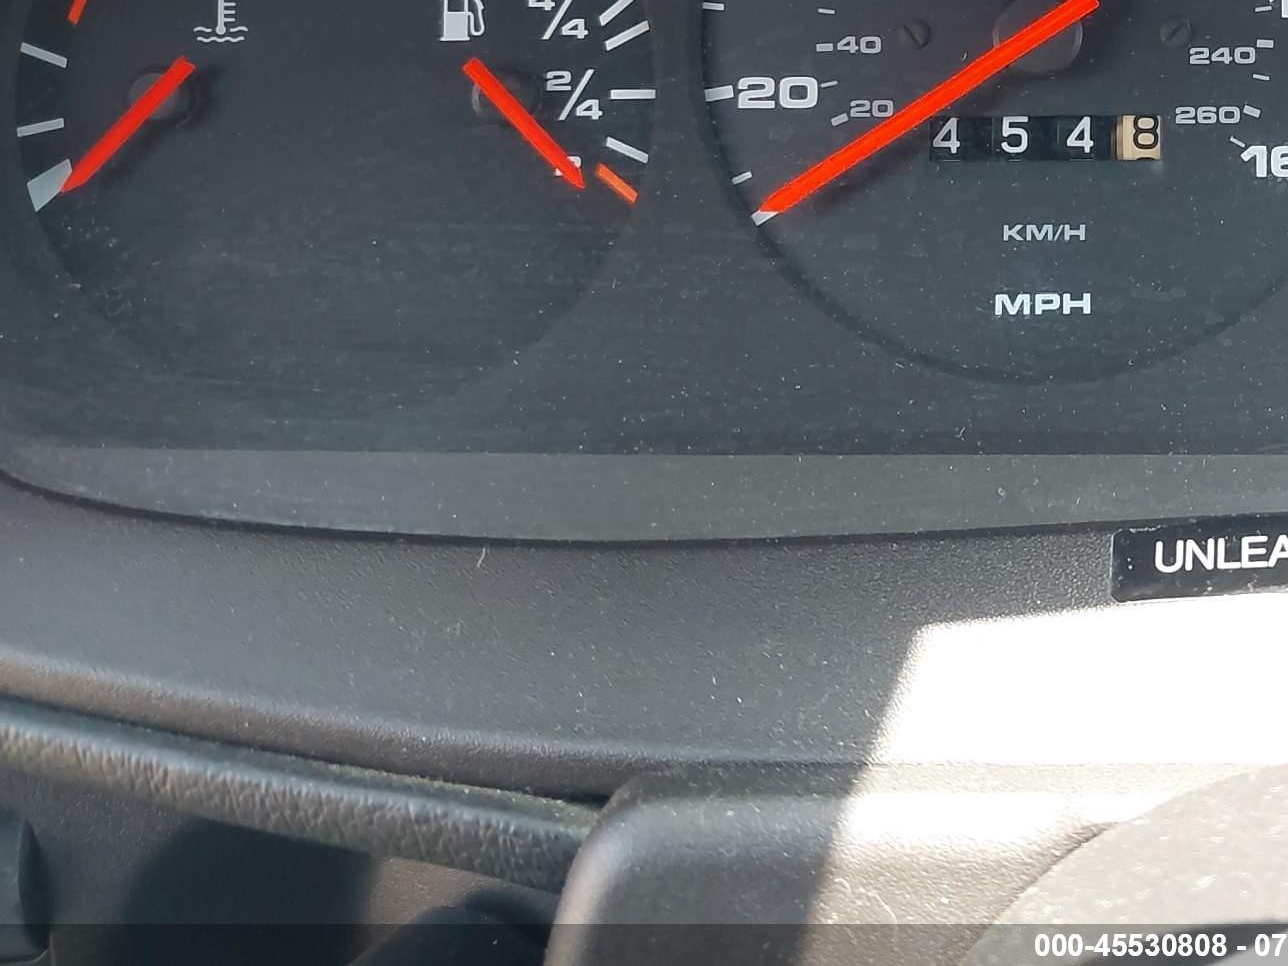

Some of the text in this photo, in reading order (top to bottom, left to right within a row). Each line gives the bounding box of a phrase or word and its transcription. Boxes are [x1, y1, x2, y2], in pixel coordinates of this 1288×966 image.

[837, 35, 882, 54] 40
[1189, 46, 1256, 65] 240
[546, 69, 604, 121] 2/4
[737, 76, 819, 110] 20
[850, 99, 894, 118] 20
[1175, 105, 1241, 125] 260
[1003, 224, 1086, 242] KM/H
[994, 293, 1091, 315] MPH
